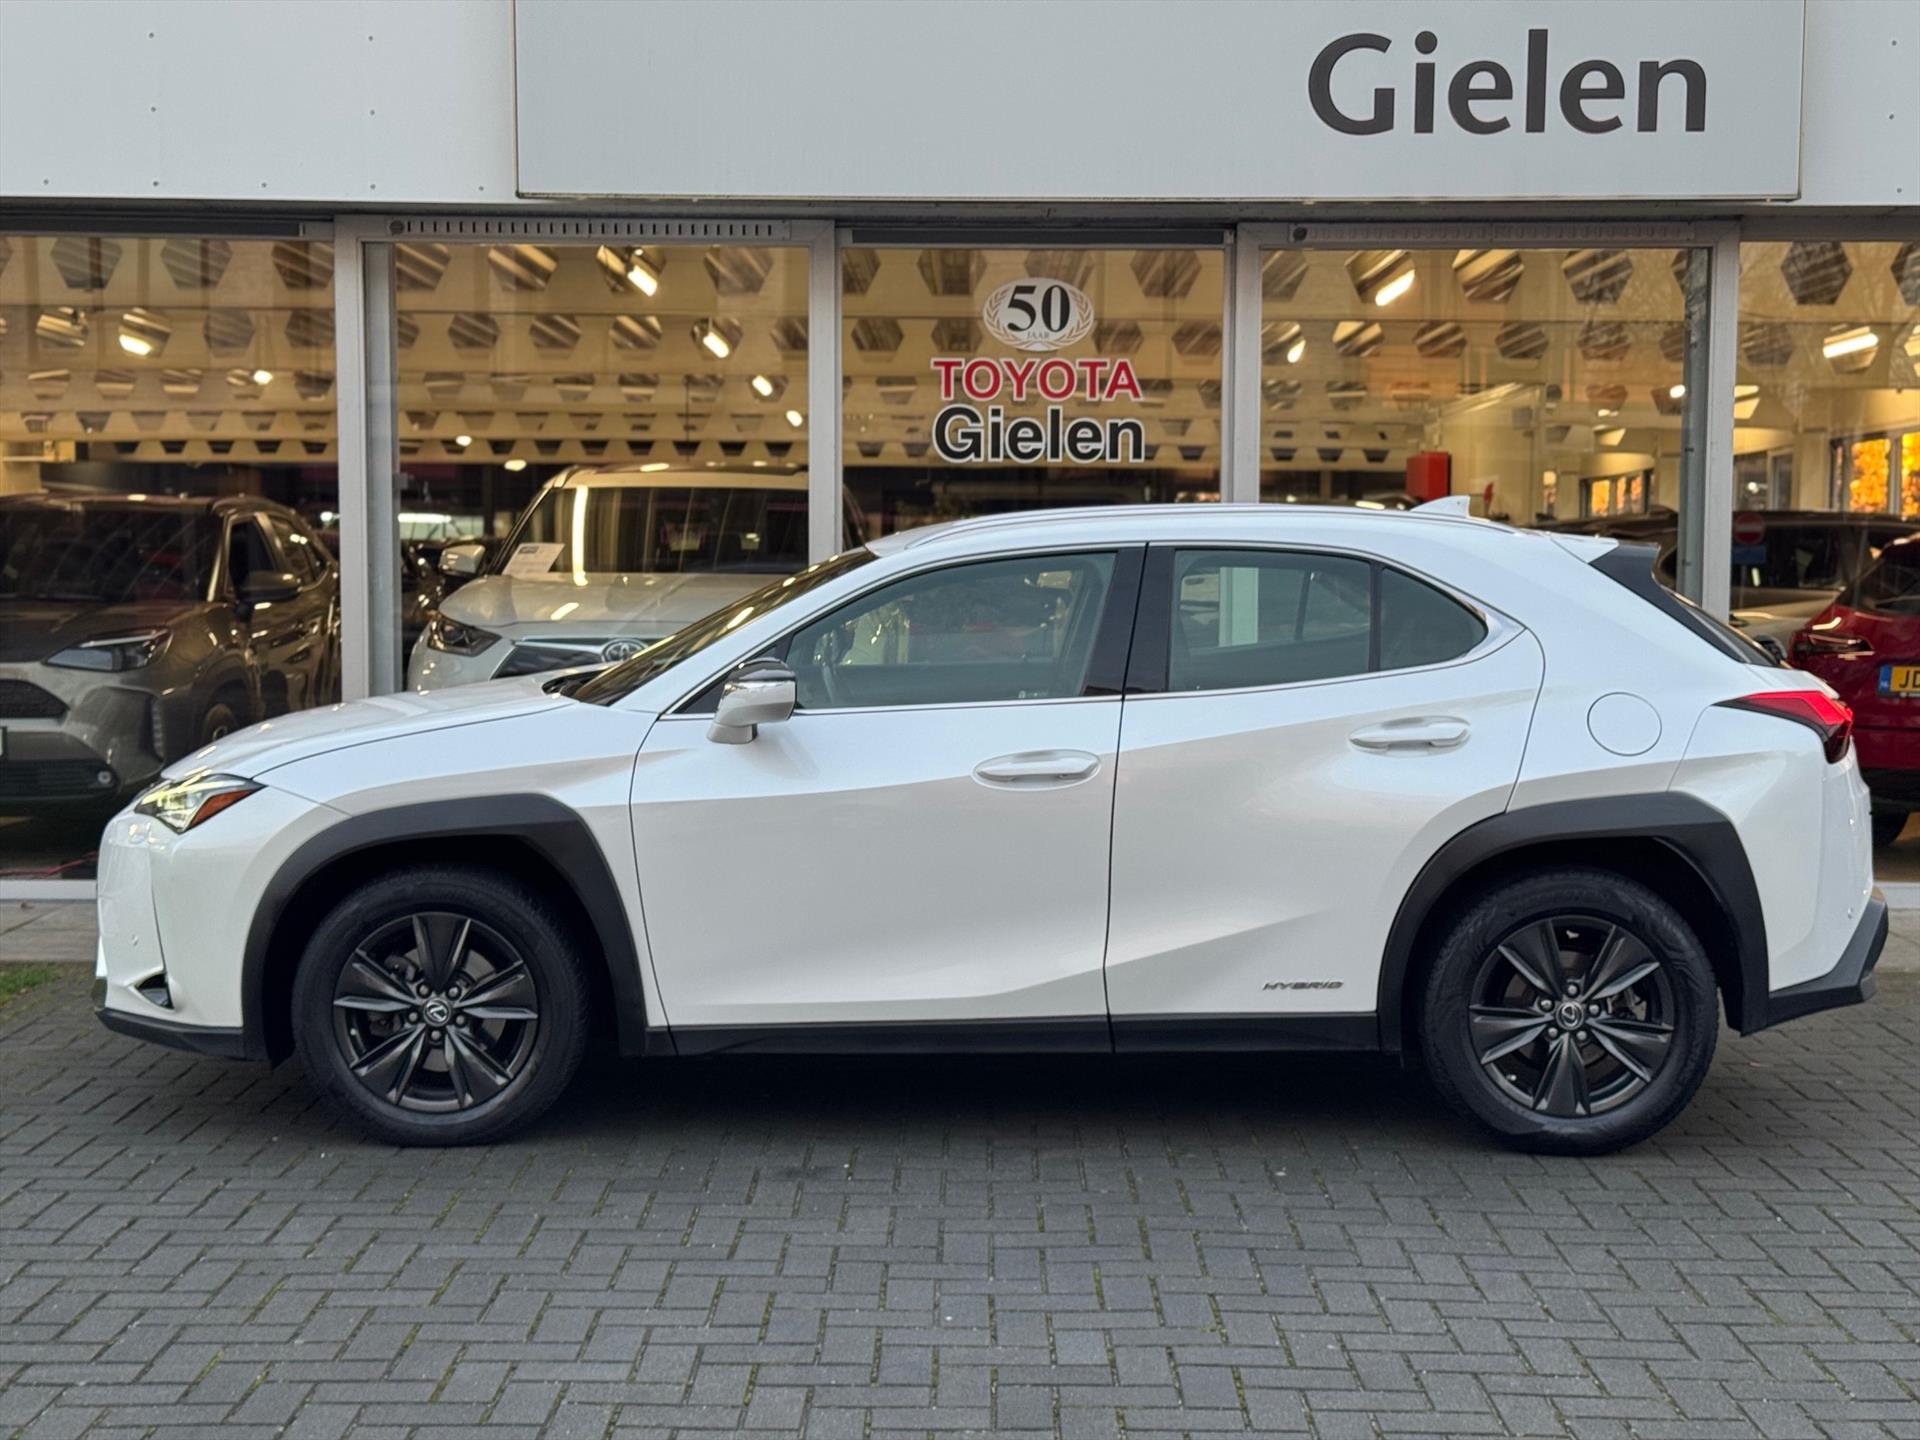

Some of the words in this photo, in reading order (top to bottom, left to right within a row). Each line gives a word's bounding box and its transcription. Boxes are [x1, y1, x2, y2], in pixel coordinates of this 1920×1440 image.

[1308, 28, 1707, 136] Gielen
[1007, 284, 1071, 333] 50
[931, 358, 1143, 401] TOYOTA
[933, 404, 1145, 463] Gielen
[1263, 981, 1344, 991] HYBRID
